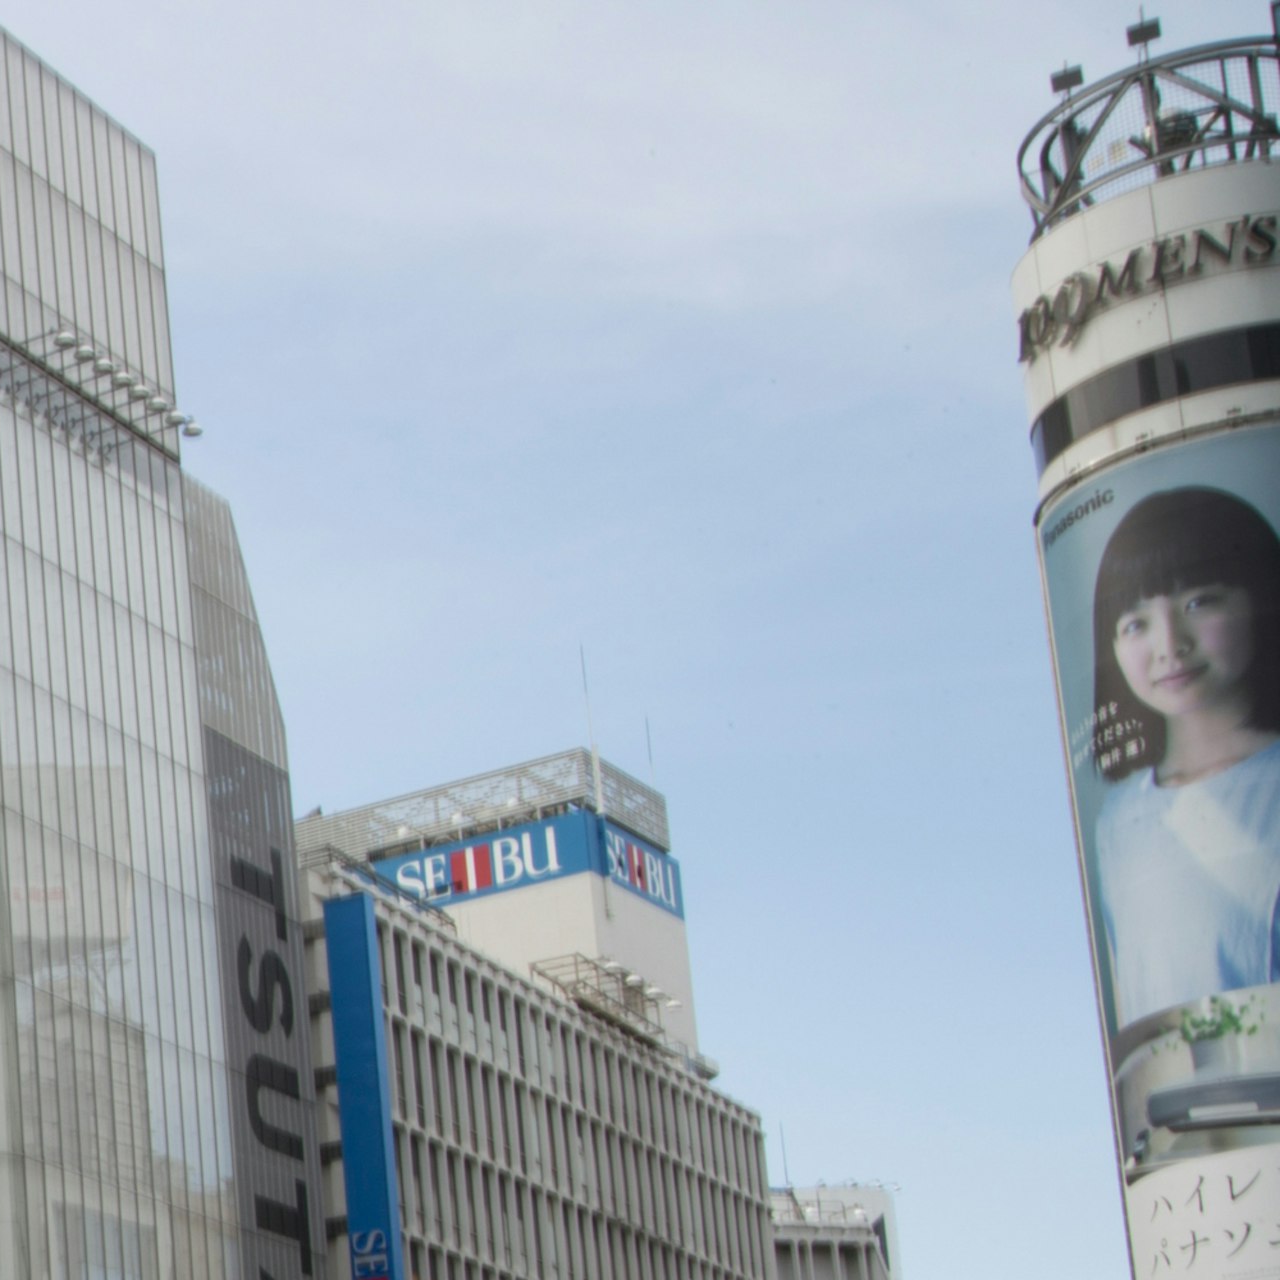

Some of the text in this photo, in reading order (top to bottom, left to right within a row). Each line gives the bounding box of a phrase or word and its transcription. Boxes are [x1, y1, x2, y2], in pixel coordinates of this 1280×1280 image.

[1097, 214, 1278, 304] MEN'S
[1044, 487, 1116, 552] Panasonic
[396, 825, 560, 898] SEIBU
[606, 829, 677, 909] SEIBU
